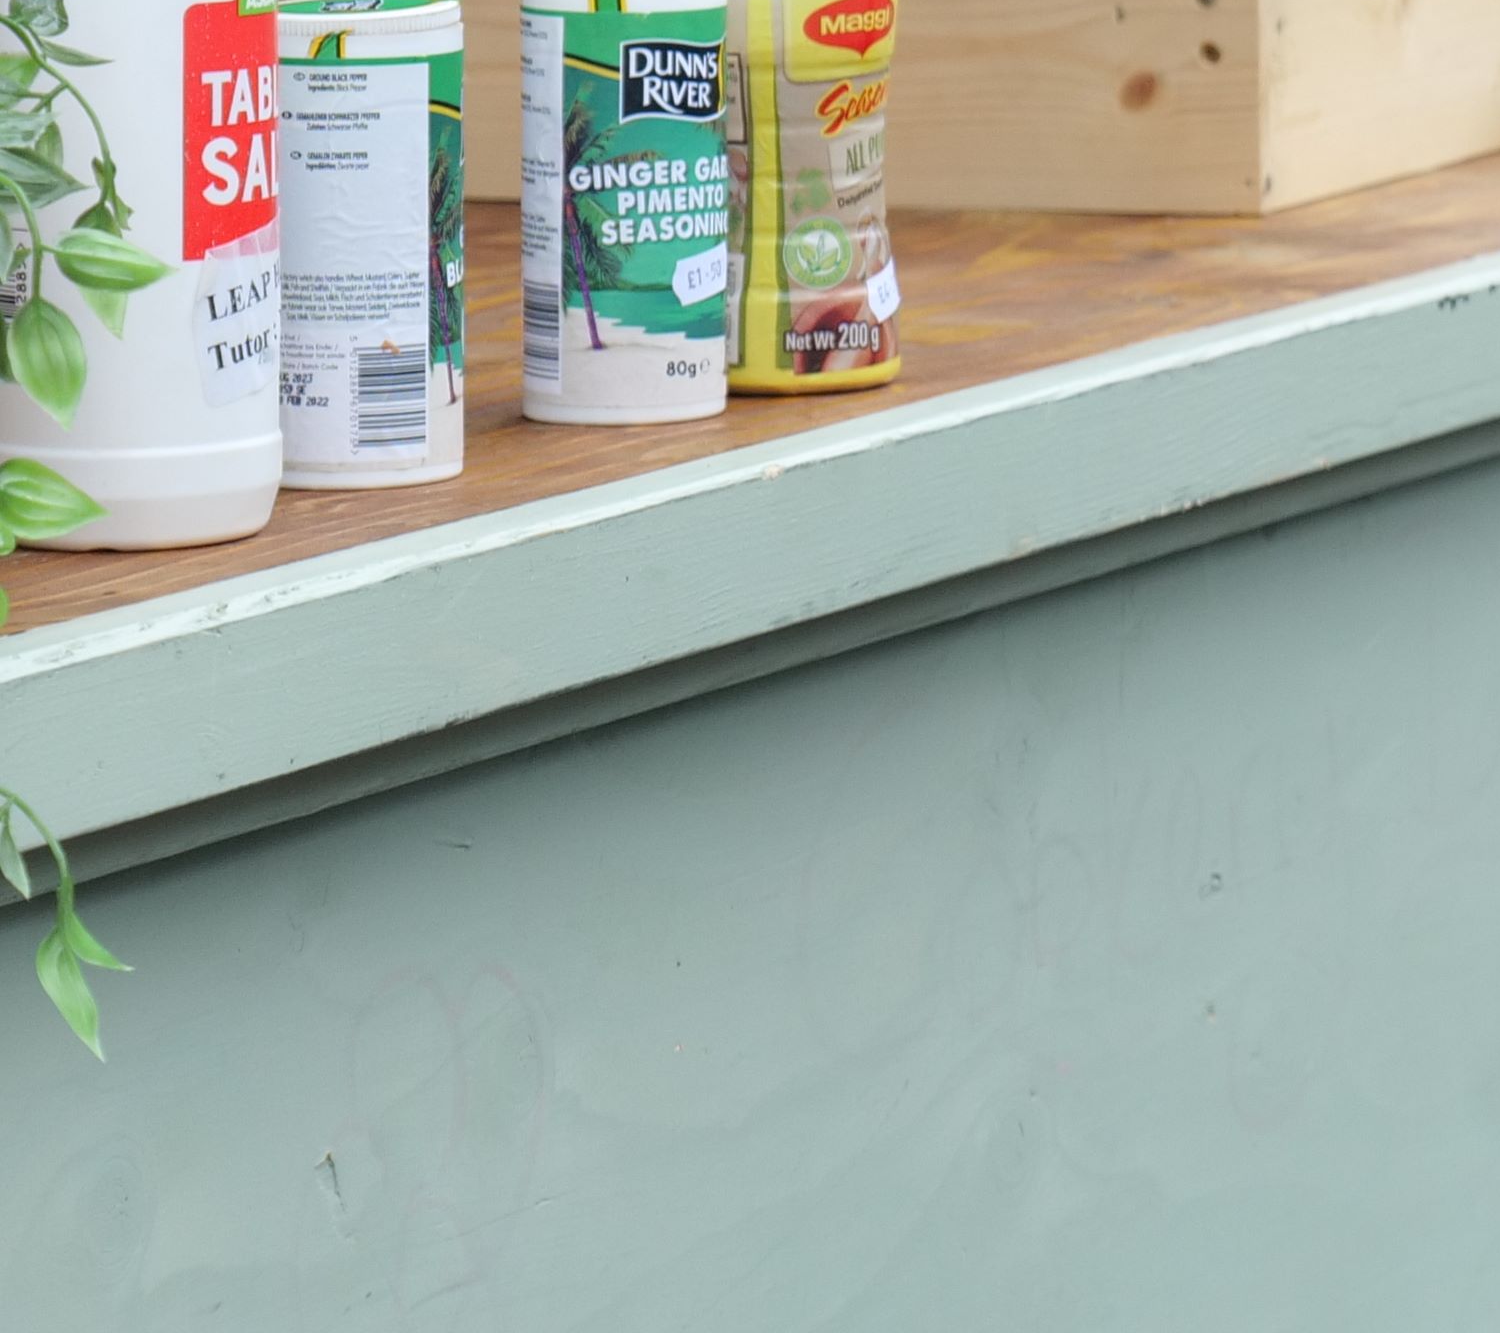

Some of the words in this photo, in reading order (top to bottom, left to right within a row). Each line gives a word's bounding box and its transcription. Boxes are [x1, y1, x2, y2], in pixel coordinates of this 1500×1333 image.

[820, 7, 889, 36] Maggi
[628, 47, 718, 79] DUNN'S
[201, 64, 279, 127] TABL
[642, 78, 712, 114] RIVER
[202, 131, 279, 206] SAL
[569, 159, 687, 192] GINGER
[695, 155, 728, 182] GAR
[617, 184, 724, 216] PIMENTO
[206, 271, 271, 322] LEAP
[785, 332, 810, 352] Net
[814, 330, 835, 350] Wt
[838, 321, 868, 349] 200
[870, 330, 880, 352] g
[666, 360, 697, 377] 80g
